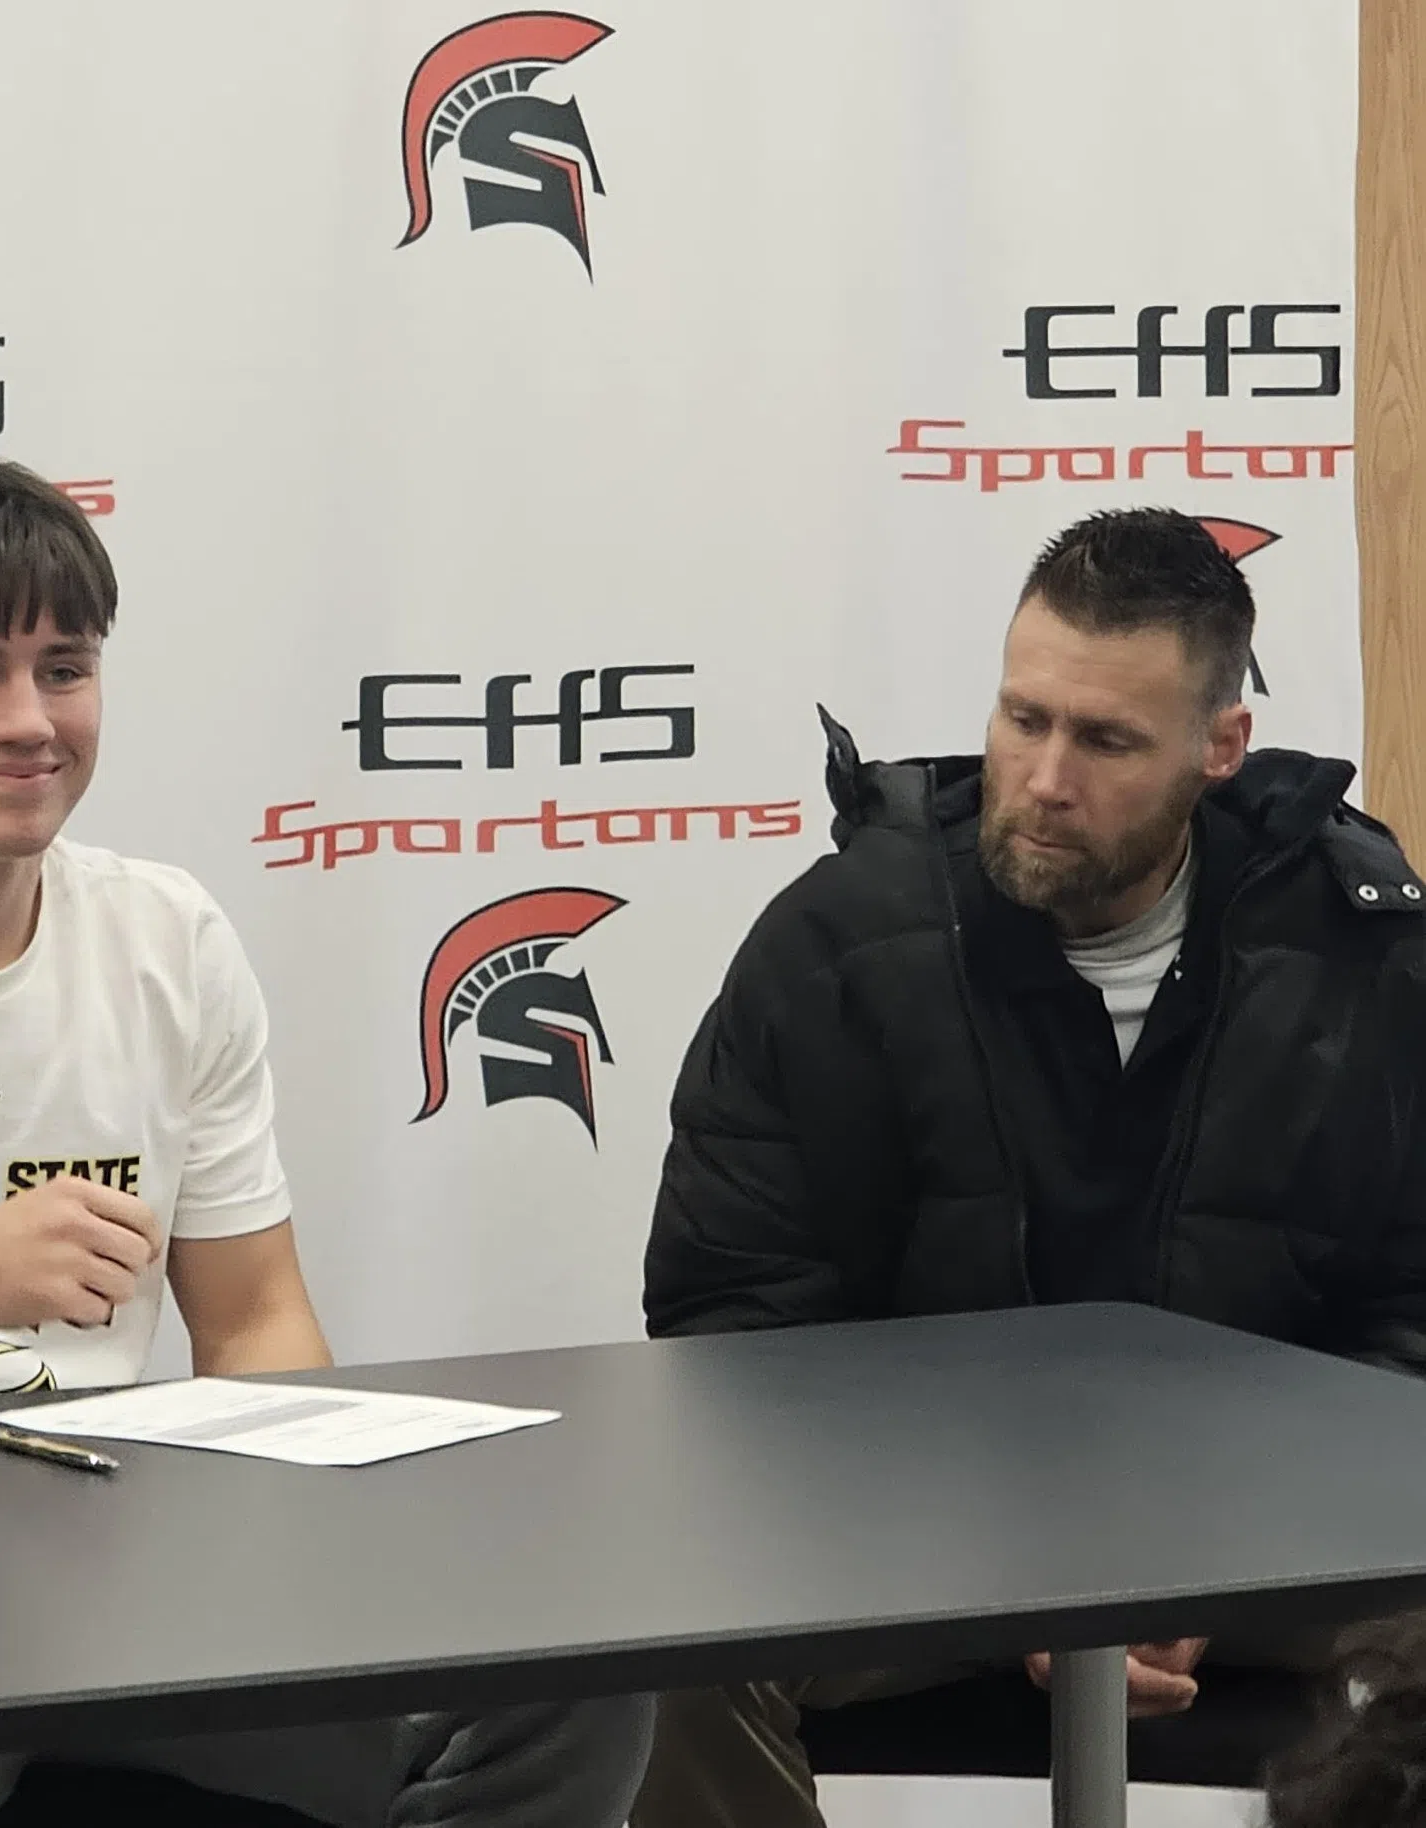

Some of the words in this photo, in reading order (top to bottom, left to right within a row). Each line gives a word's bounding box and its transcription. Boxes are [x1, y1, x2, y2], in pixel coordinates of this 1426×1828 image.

[1002, 304, 1342, 399] EHS
[886, 419, 1356, 493] Sparta
[342, 664, 695, 771] EHS
[251, 799, 802, 870] Spartans
